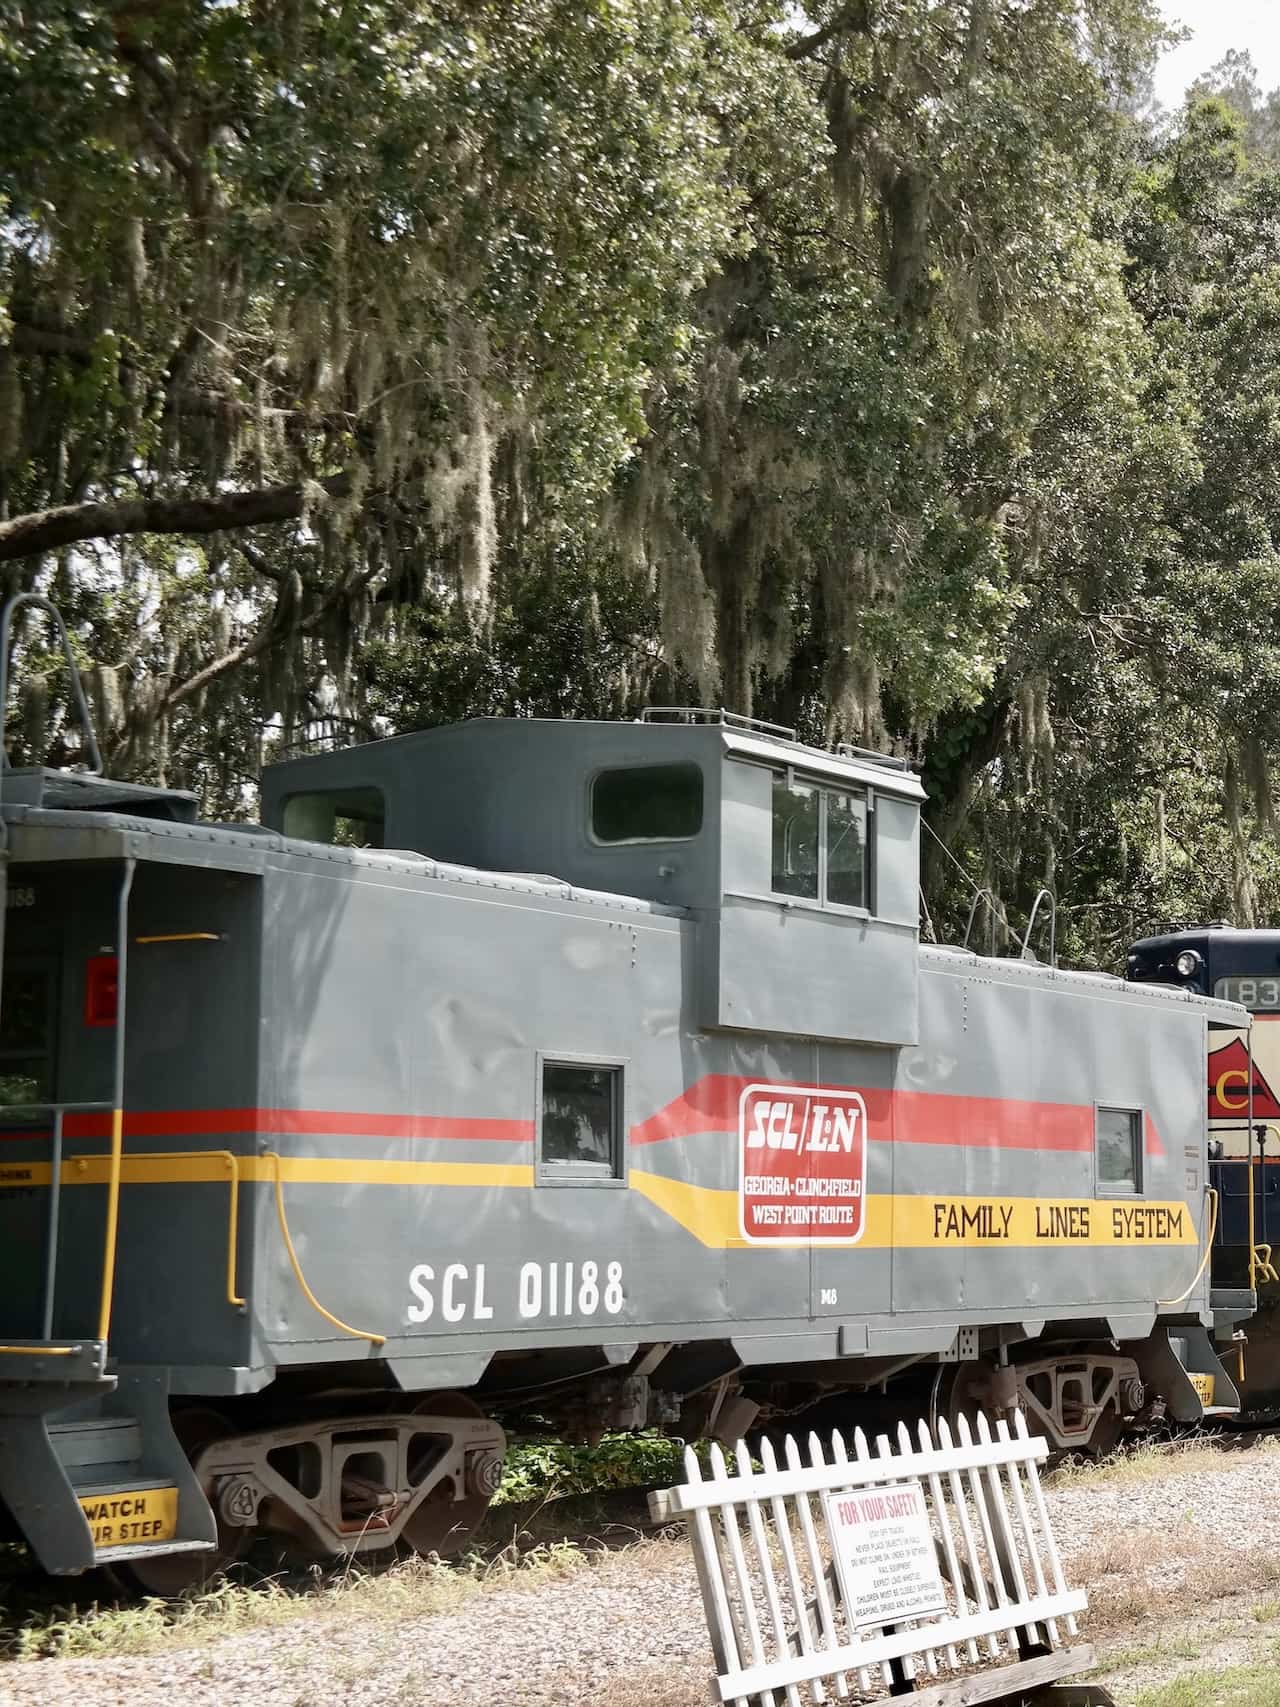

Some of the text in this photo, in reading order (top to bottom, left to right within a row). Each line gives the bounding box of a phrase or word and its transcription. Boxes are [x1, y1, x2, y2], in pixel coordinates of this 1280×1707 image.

[1216, 1070, 1250, 1110] C
[752, 1205, 854, 1224] WEST POINT ROUTE
[933, 1204, 1182, 1238] FAMILY LINES SYSTEM
[407, 1260, 624, 1323] SCL 01188
[82, 1499, 146, 1521] WATCH
[838, 1493, 919, 1525] FOR YOUR SAFETY
[119, 1520, 162, 1539] STEP
